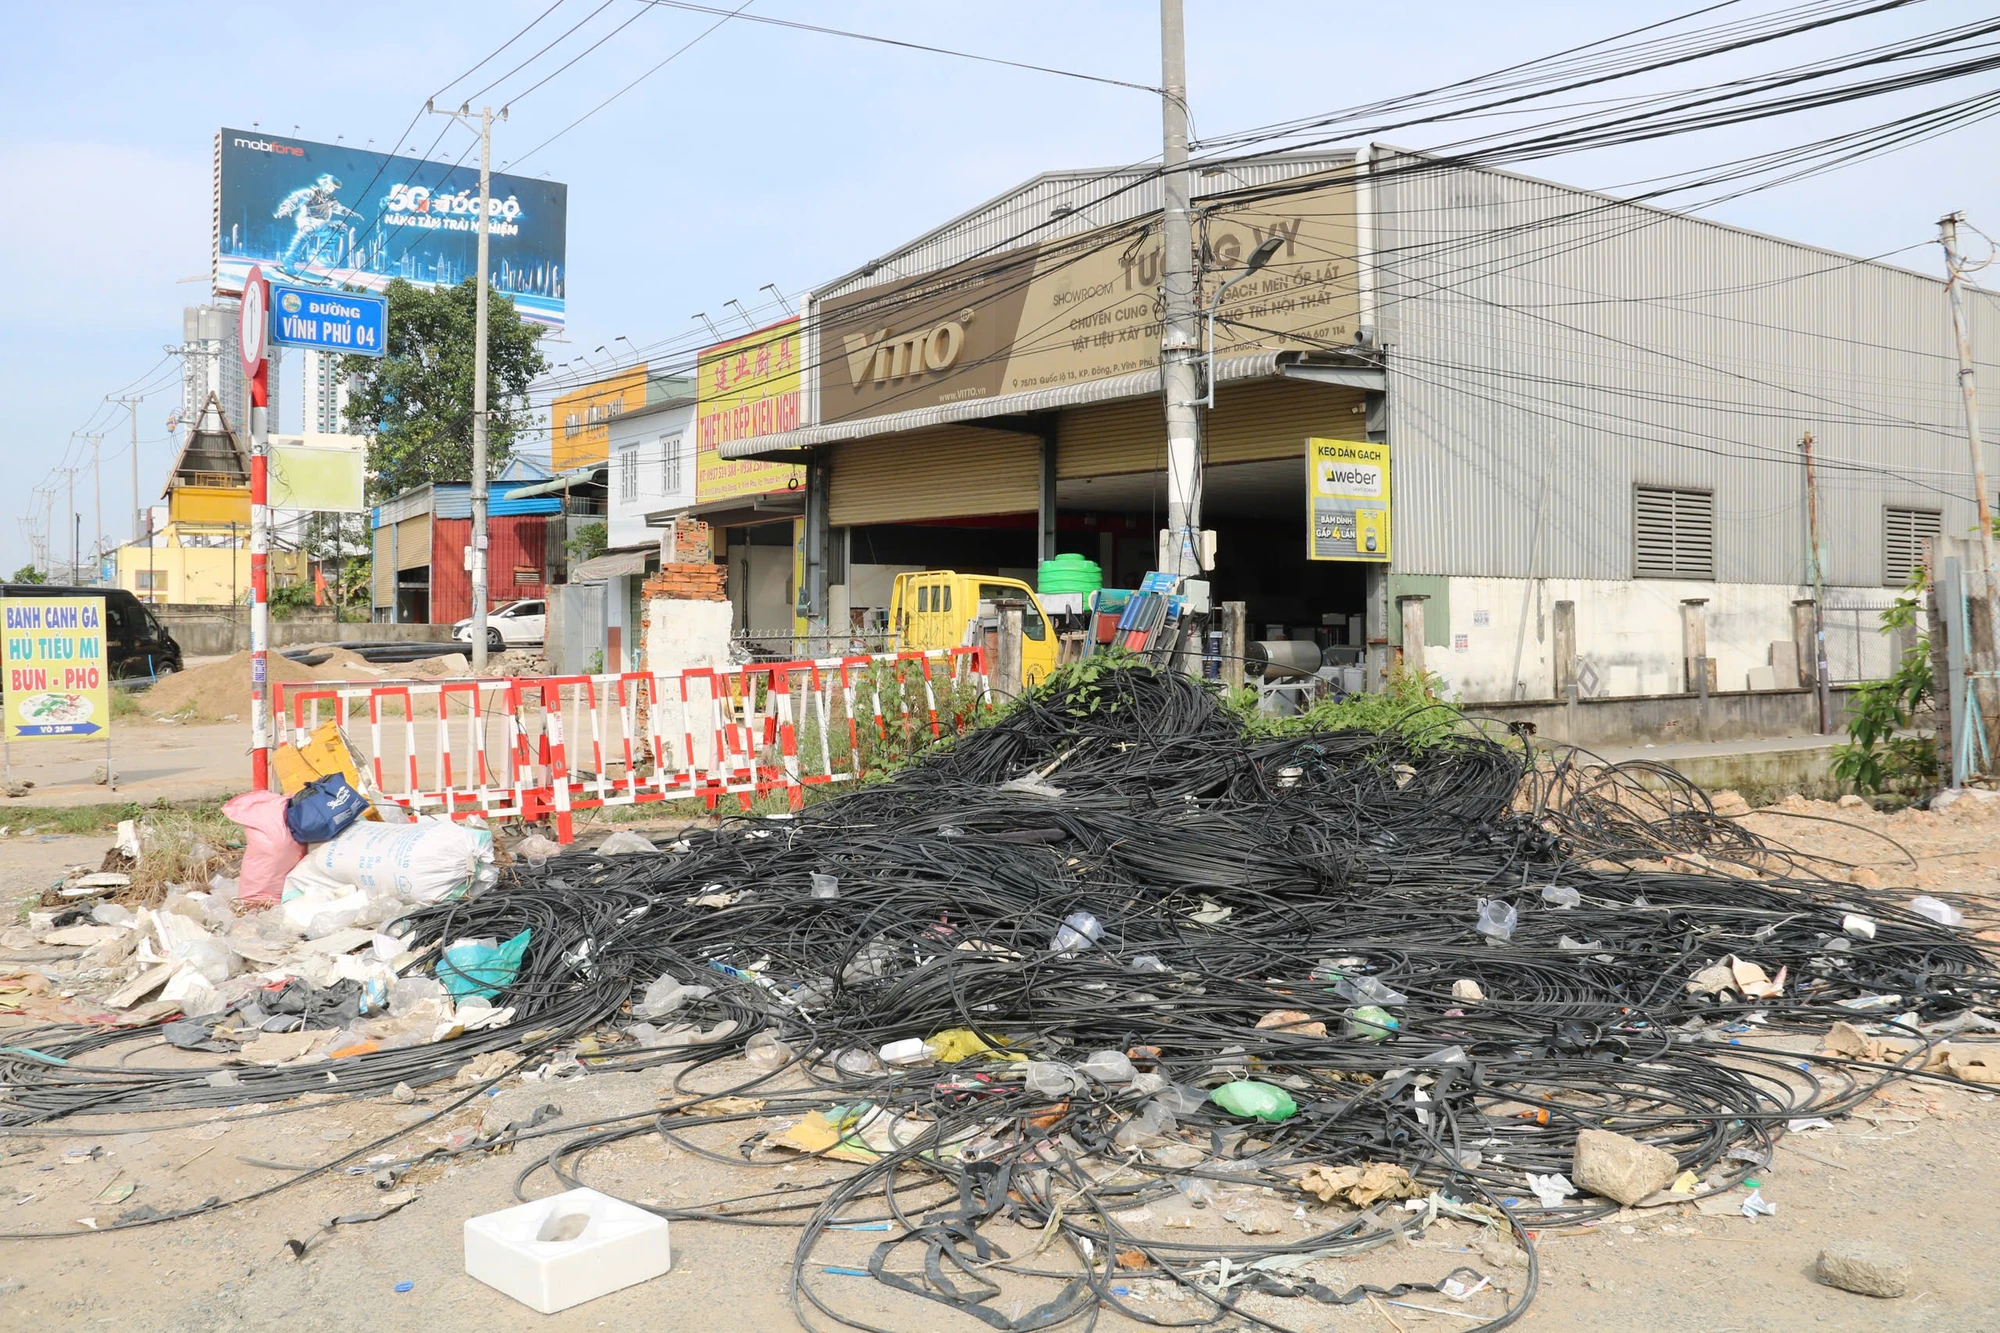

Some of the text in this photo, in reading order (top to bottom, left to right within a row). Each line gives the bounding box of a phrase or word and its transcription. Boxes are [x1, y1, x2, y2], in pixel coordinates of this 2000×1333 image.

[234, 138, 304, 156] mobifone
[388, 183, 430, 213] 5G
[385, 213, 416, 227] NÂNG
[471, 220, 518, 237] NHIỆM
[1252, 218, 1302, 258] VY
[1053, 282, 1114, 306] SHOWROOM
[1222, 282, 1258, 302] GẠCH
[1293, 265, 1314, 285] ỐP
[1317, 262, 1340, 283] LÁT
[309, 302, 360, 319] ĐƯỜNG
[1249, 299, 1268, 318] TRÍ
[1271, 299, 1295, 316] NỘI
[1300, 284, 1332, 310] THẤT
[282, 315, 375, 346] VĨNH PHÚ 04
[1070, 310, 1111, 330] CHUYÊN
[1115, 305, 1148, 321] CUNG
[1072, 335, 1093, 352] VẬT
[1094, 330, 1115, 348] LIỆU
[1118, 324, 1141, 343] XÂY
[1313, 328, 1330, 338] 607
[1332, 325, 1346, 336] 114
[843, 321, 964, 388] VITTO
[1020, 378, 1037, 387] 75/13
[1040, 372, 1058, 384] Quốc
[1059, 373, 1066, 383] lộ
[1068, 371, 1077, 380] 13,
[1079, 368, 1090, 377] KP.
[1113, 364, 1120, 373] P.
[1121, 361, 1137, 371] Vĩnh
[1139, 357, 1155, 368] Phú,
[939, 387, 986, 402] www.VITTO.vn
[1318, 446, 1381, 461] KEO DÁN GẠCH
[1335, 468, 1376, 485] weber
[1320, 514, 1352, 525] BÁM DÍNH
[1332, 526, 1341, 541] 4
[6, 602, 99, 629] BÁNH CANH GÀ
[9, 631, 99, 660] HỦ TIẾU MÌ
[12, 664, 46, 690] BÚN
[65, 661, 100, 690] PHỞ
